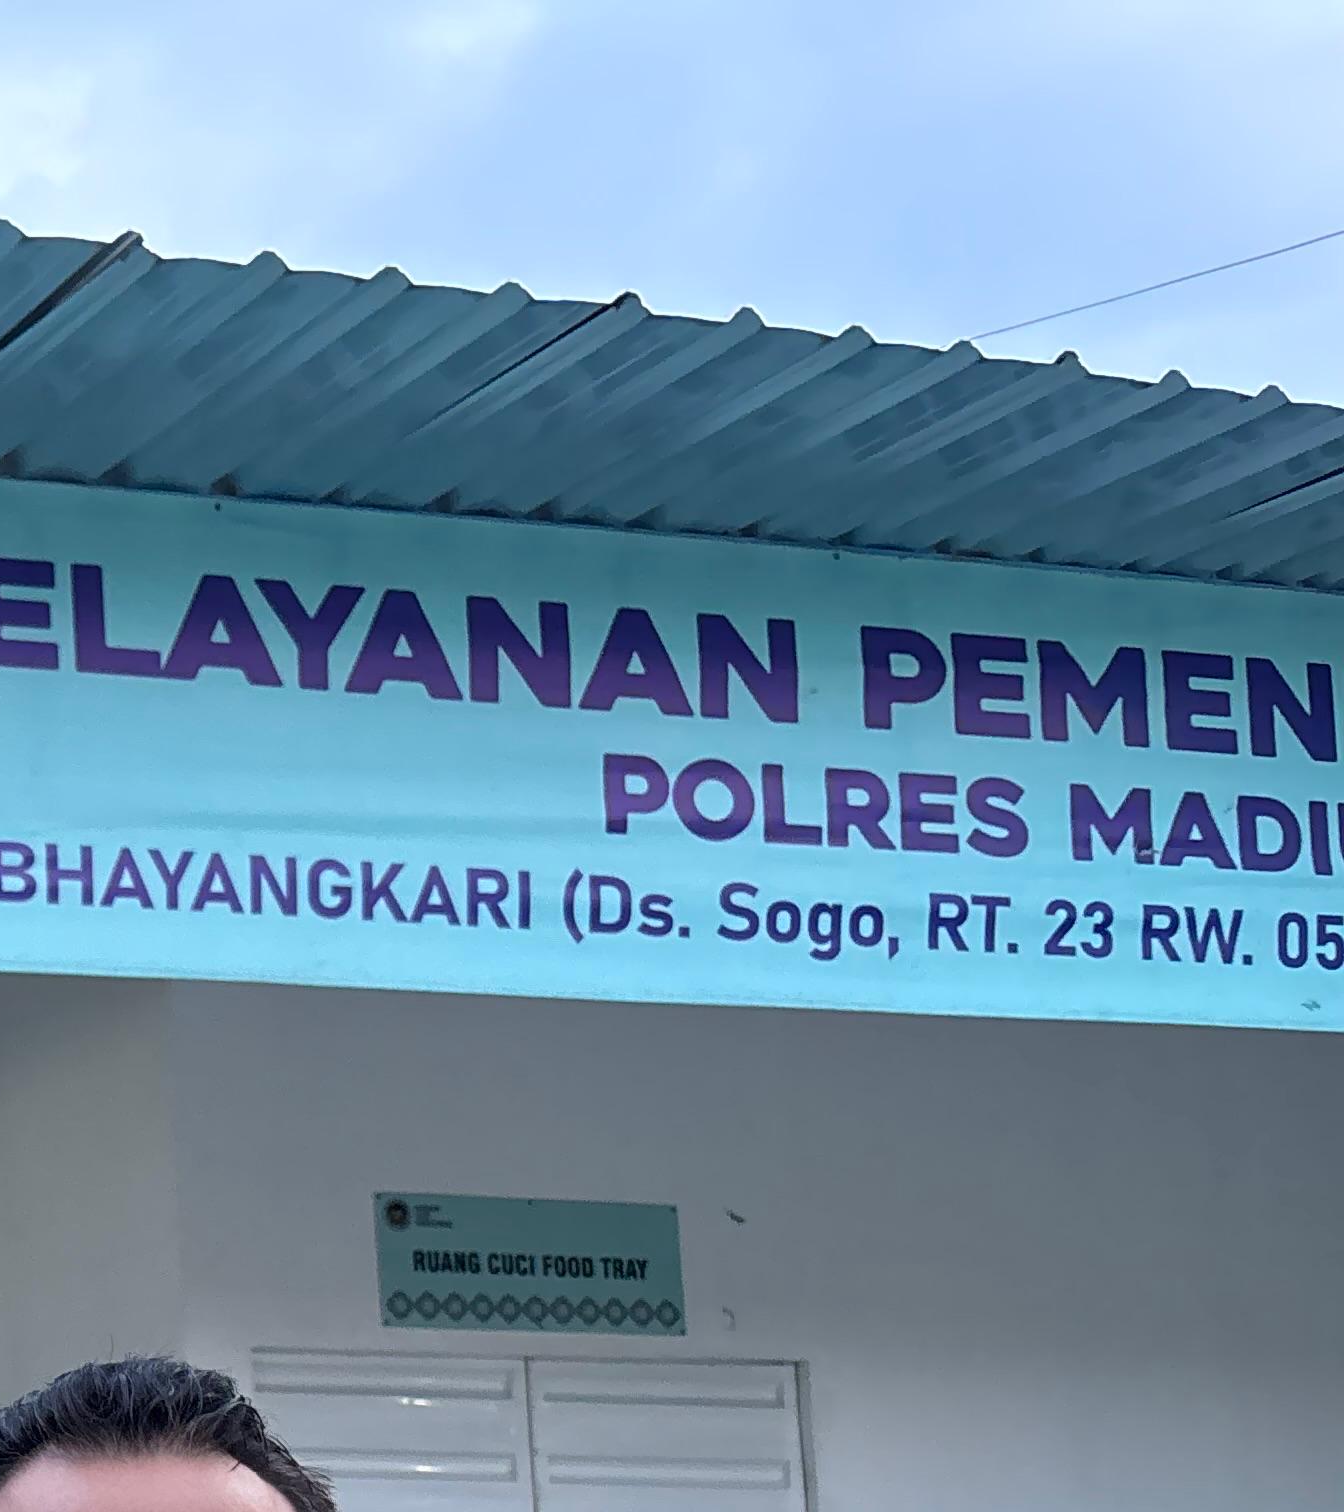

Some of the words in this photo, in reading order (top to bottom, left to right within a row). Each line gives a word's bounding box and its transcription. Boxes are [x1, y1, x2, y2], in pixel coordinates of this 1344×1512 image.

[603, 753, 1028, 858] POLRES
[563, 870, 690, 944] (Ds.
[718, 883, 900, 962] Sogo,
[928, 893, 1019, 954] RT.
[1043, 900, 1113, 958] 23
[1142, 904, 1253, 966] RW.
[1278, 912, 1344, 970] 05
[413, 1249, 479, 1275] RUANG
[488, 1253, 536, 1277] CUCI
[543, 1254, 594, 1279] FOOD
[600, 1256, 649, 1281] TRAY
